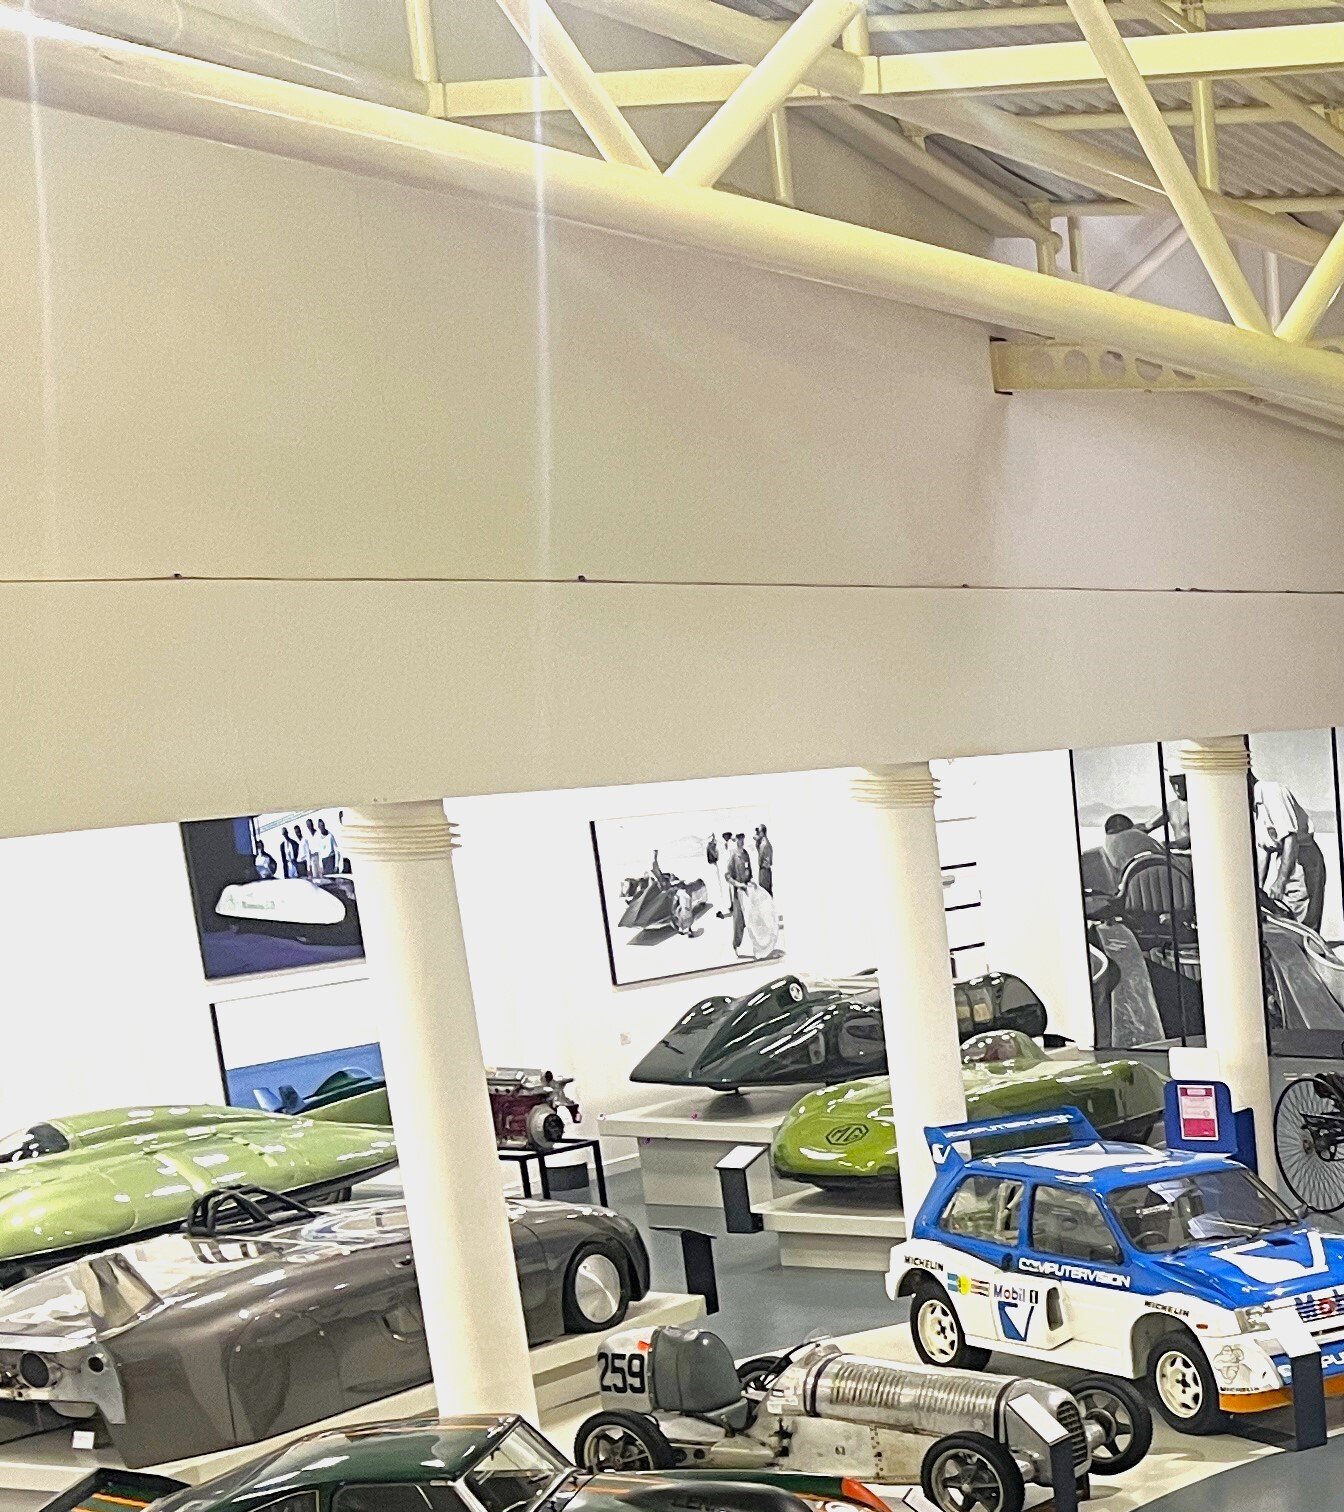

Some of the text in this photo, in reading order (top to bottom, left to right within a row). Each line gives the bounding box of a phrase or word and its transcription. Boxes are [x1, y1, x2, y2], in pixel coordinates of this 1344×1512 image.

[903, 1255, 945, 1272] MICHELIN
[1018, 1257, 1131, 1288] COMPUTERVISION
[993, 1283, 1026, 1302] Mobil
[1144, 1300, 1190, 1317] MICHELIN
[597, 1351, 646, 1393] 259
